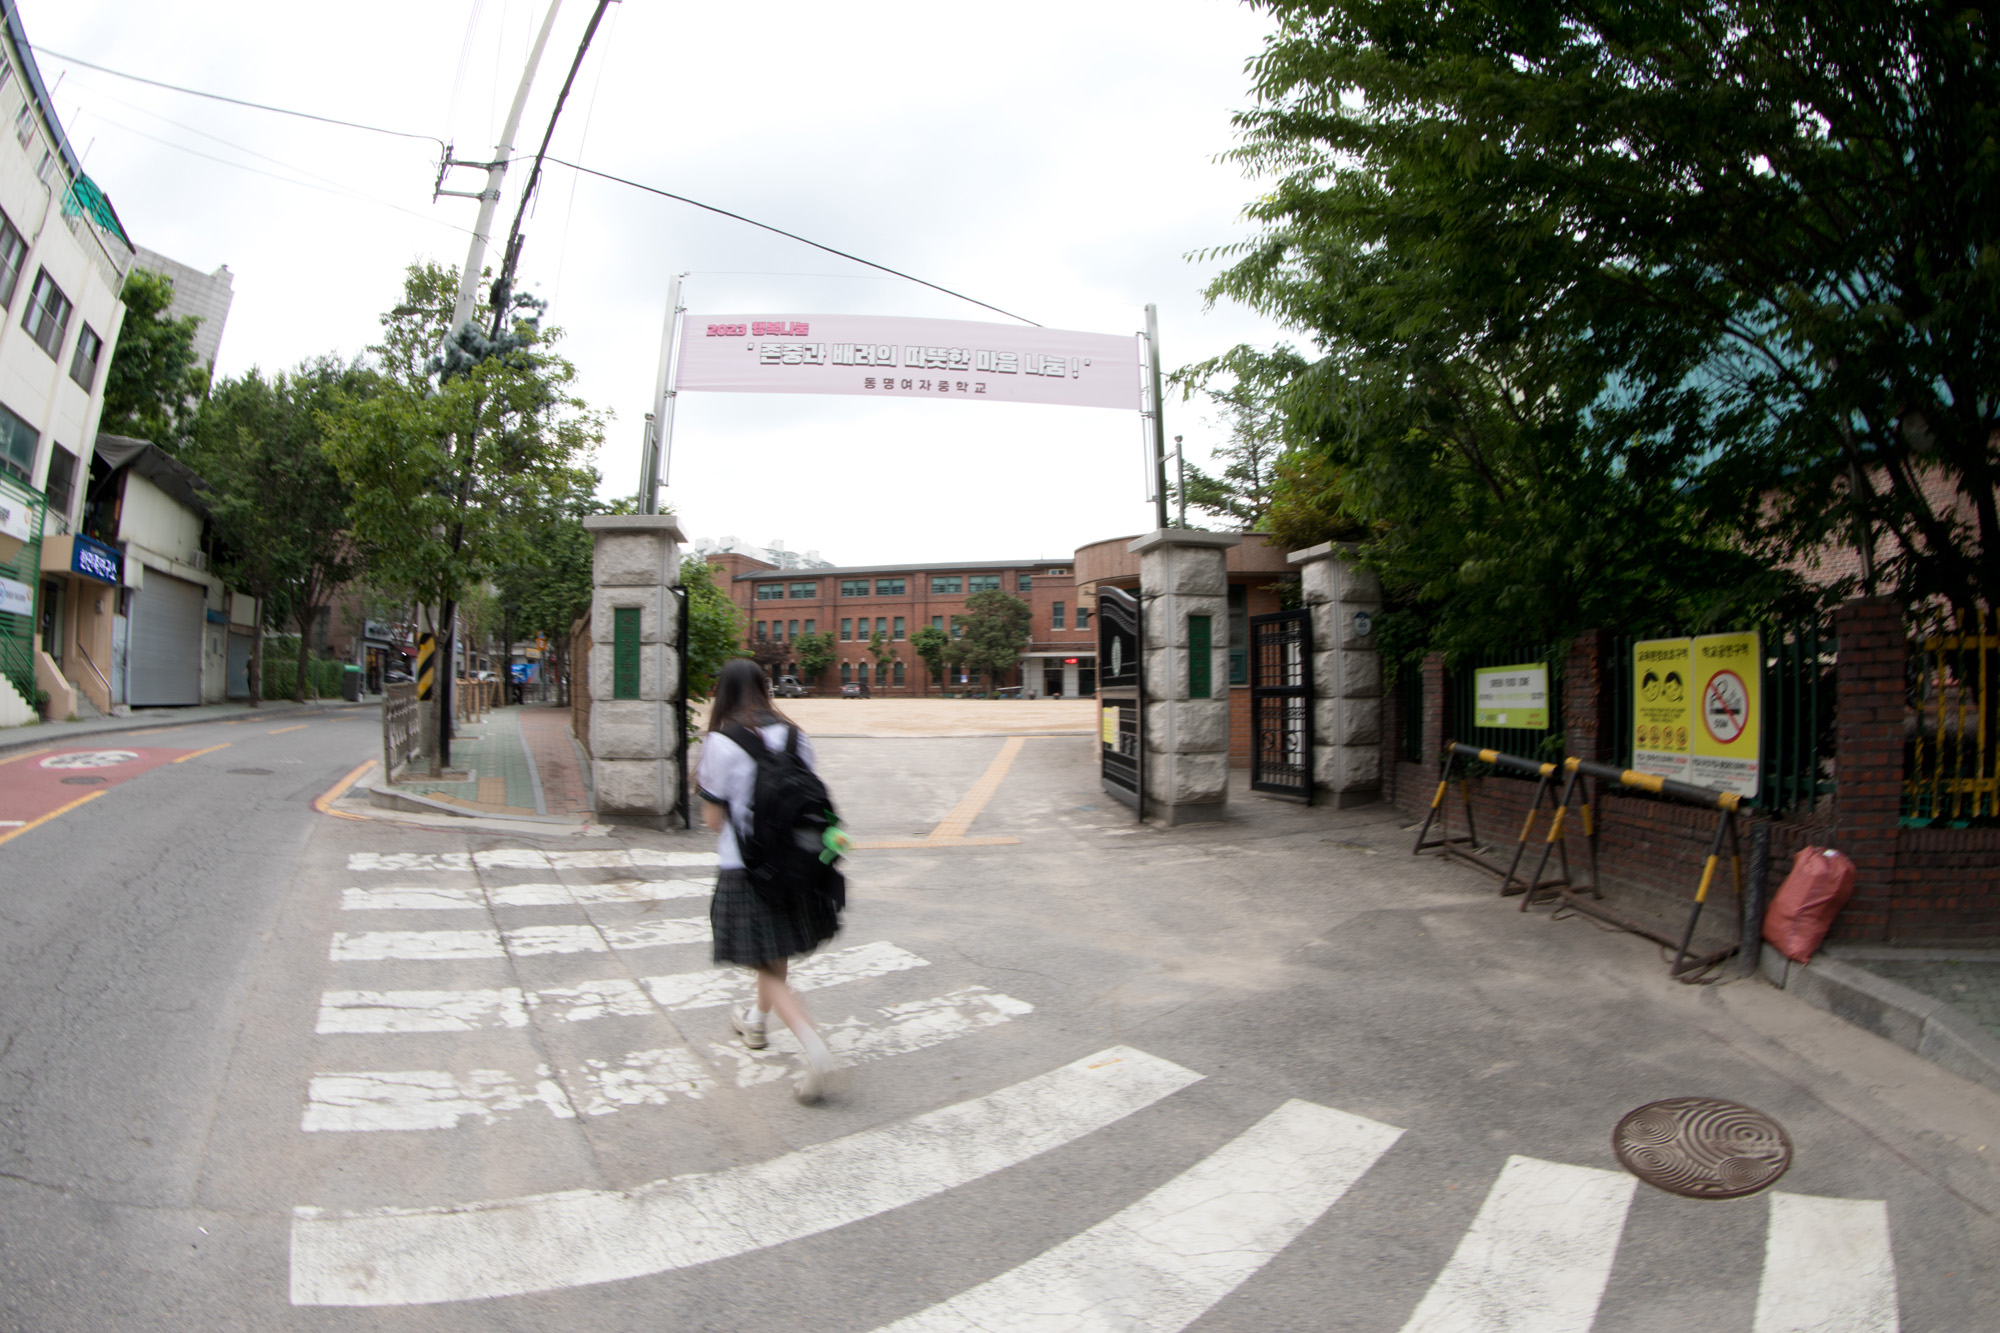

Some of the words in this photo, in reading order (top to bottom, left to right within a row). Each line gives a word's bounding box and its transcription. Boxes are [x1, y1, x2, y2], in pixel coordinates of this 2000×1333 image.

[706, 323, 747, 337] 2023
[752, 321, 809, 336] 행복나눔
[760, 342, 826, 365] 존중과
[832, 343, 898, 367] 배려의
[904, 345, 970, 371] 따뜻한
[976, 350, 1018, 374] 마음
[864, 377, 987, 394] 동명여자중학교
